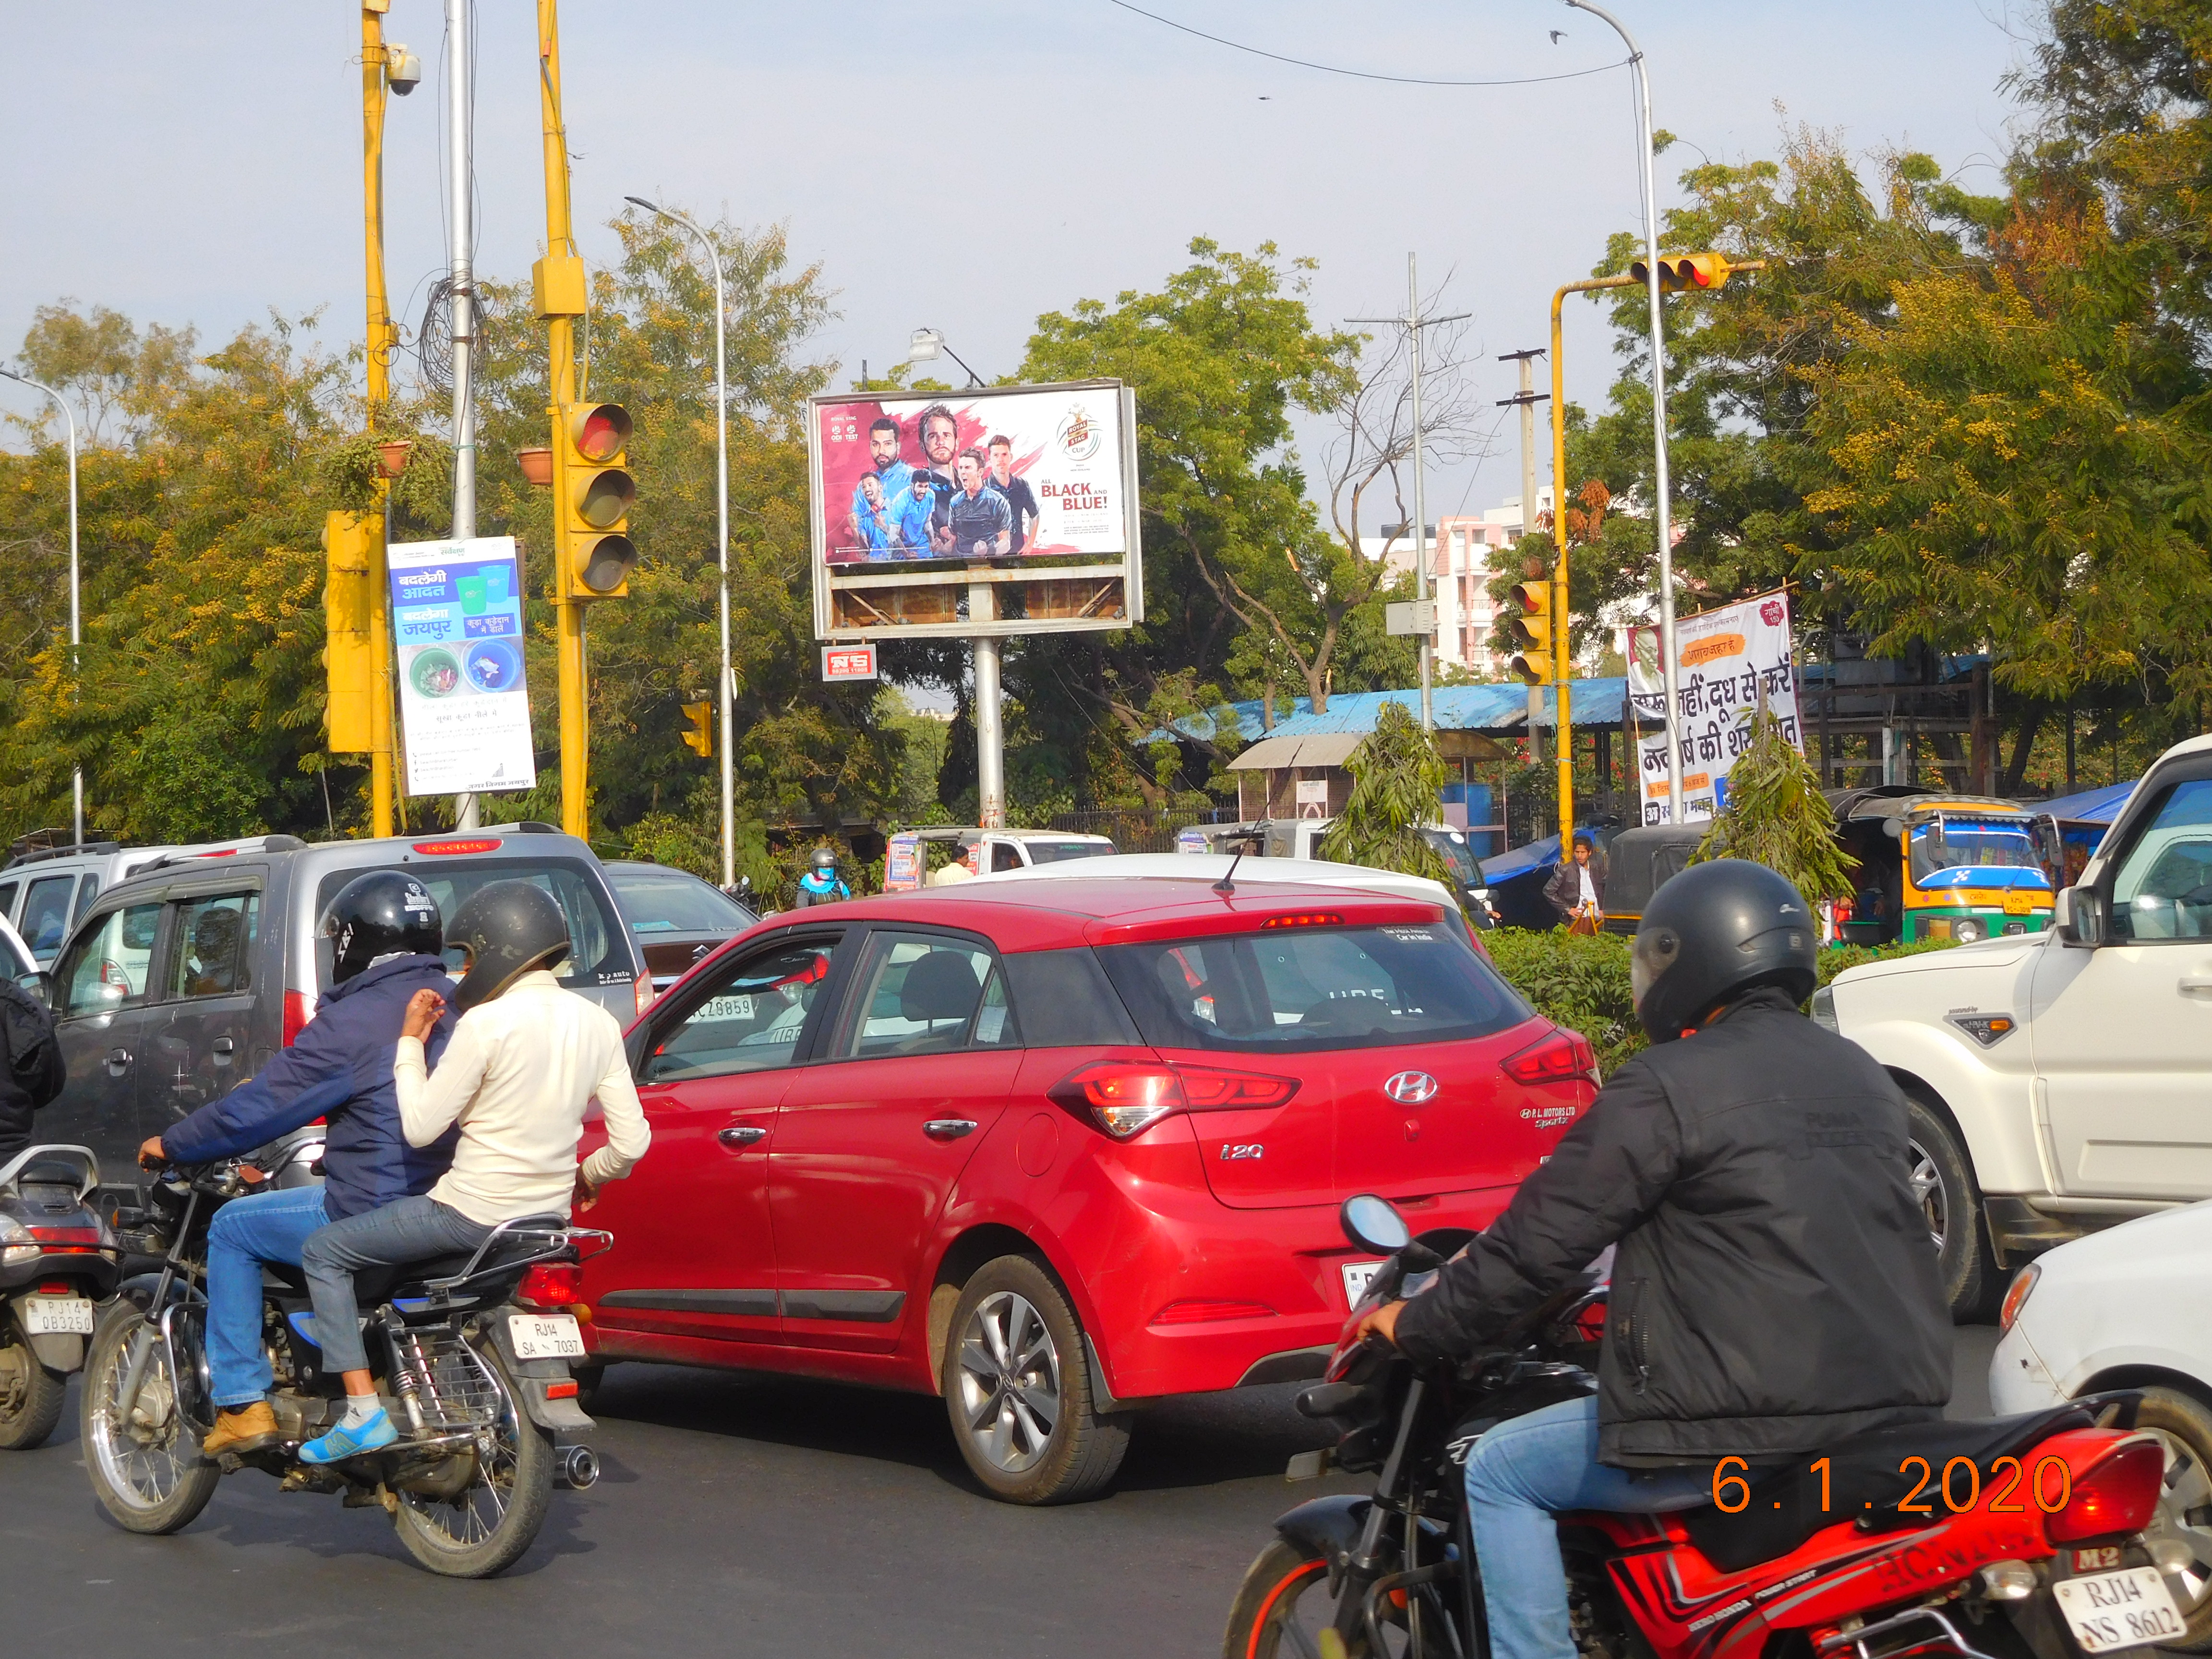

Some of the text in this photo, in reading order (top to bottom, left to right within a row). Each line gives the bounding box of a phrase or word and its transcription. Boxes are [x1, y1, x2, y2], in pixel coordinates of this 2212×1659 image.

[1069, 421, 1086, 433] ROYAL
[1070, 435, 1085, 445] STAG
[1041, 482, 1092, 497] BLACK
[1063, 496, 1107, 510] BLUE!
[398, 570, 447, 586] बदलेगी
[402, 585, 446, 599] आदत
[402, 607, 449, 621] बदलेगा
[1764, 603, 1779, 616] गांधी
[402, 620, 452, 640] जयपुर
[1688, 647, 1709, 660] शराब
[1709, 642, 1727, 655] जहर
[830, 655, 868, 668] NS
[1741, 661, 1757, 703] से
[1697, 721, 1723, 762] की
[1543, 1107, 1565, 1117] MOTORS
[1565, 1106, 1575, 1116] LTD
[1220, 1144, 1264, 1160] i20
[1350, 1284, 1362, 1292] IND
[48, 1301, 81, 1314] RJ14
[535, 1323, 557, 1336] RJ14
[522, 1340, 578, 1355] SA 7037
[2078, 1546, 2120, 1569] M2
[2081, 1576, 2143, 1608] RJ14
[2079, 1606, 2179, 1644] NS 8612
